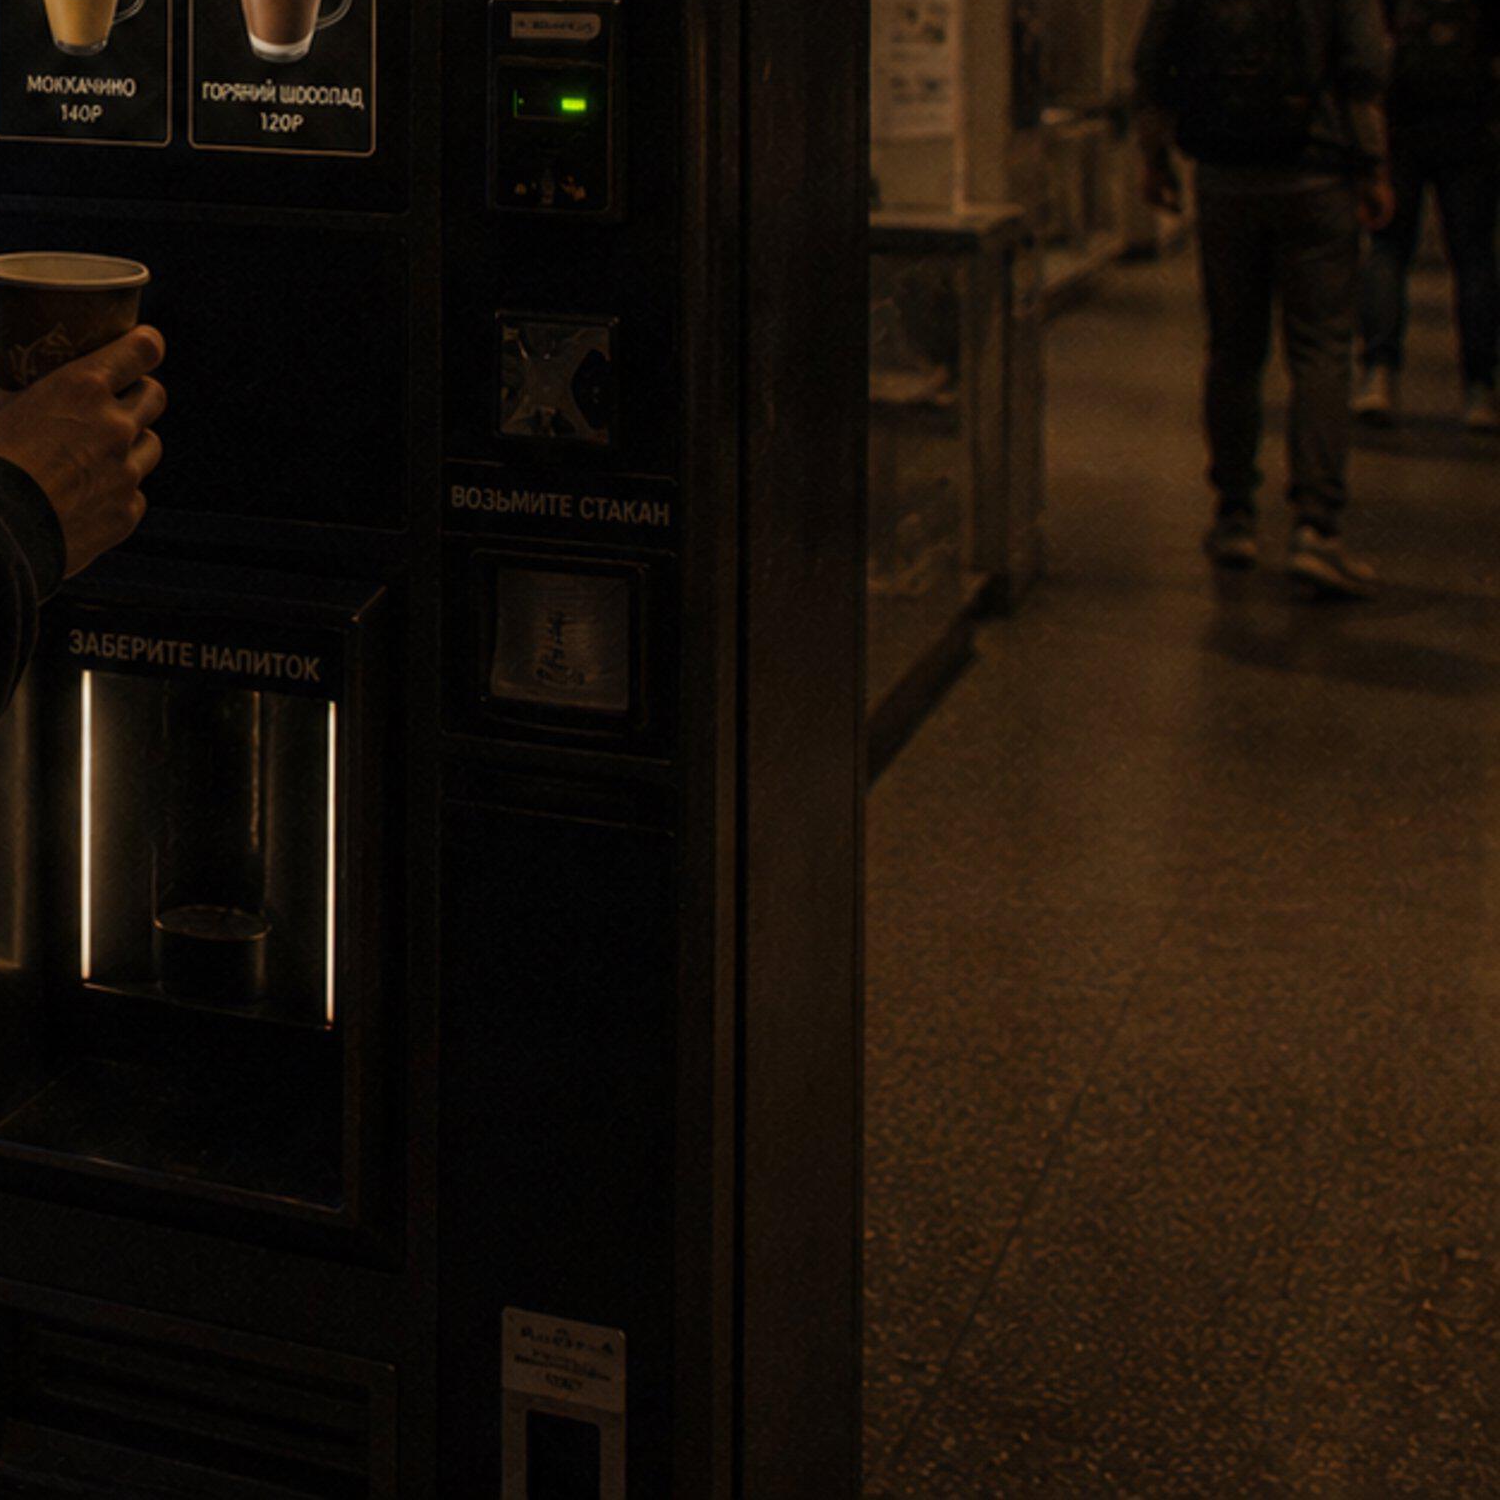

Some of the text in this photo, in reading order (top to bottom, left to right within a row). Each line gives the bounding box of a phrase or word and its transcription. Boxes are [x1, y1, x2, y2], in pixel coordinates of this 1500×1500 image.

[450, 484, 671, 527] ВОЗЬМИТЕ СТАКАН
[68, 628, 323, 684] ЗАБЕРИТЕ НАПИТОК
